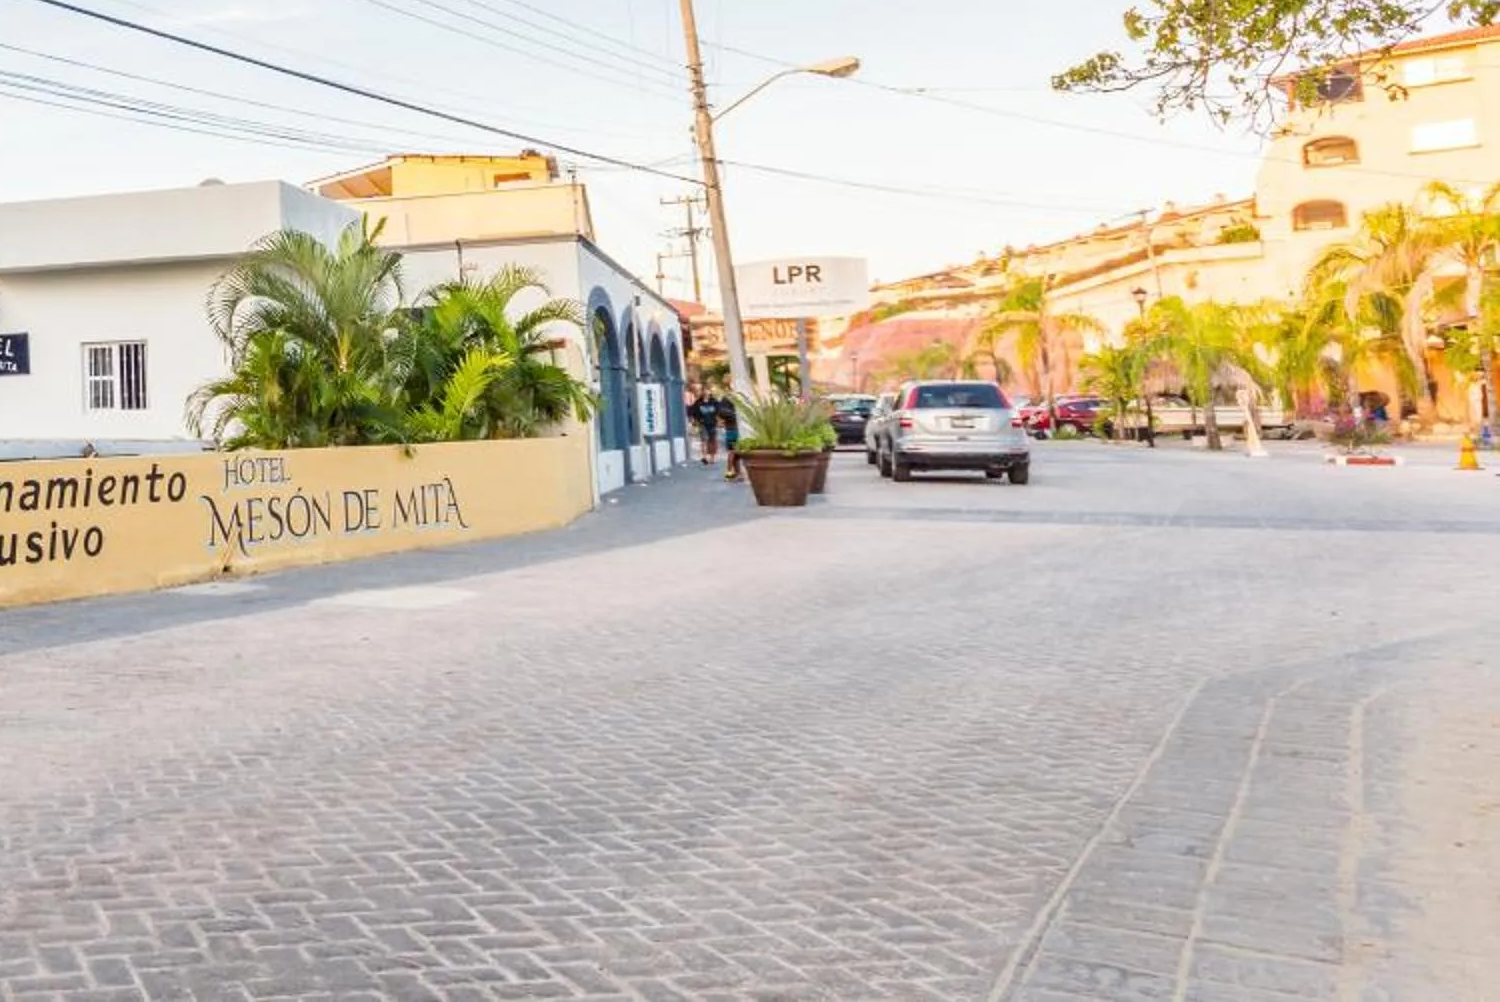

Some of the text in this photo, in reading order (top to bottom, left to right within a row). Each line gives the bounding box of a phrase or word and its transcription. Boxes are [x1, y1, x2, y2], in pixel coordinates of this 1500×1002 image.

[773, 265, 821, 284] LPR
[223, 455, 291, 491] HOTEL
[201, 477, 469, 556] MESÓN DE MITA
